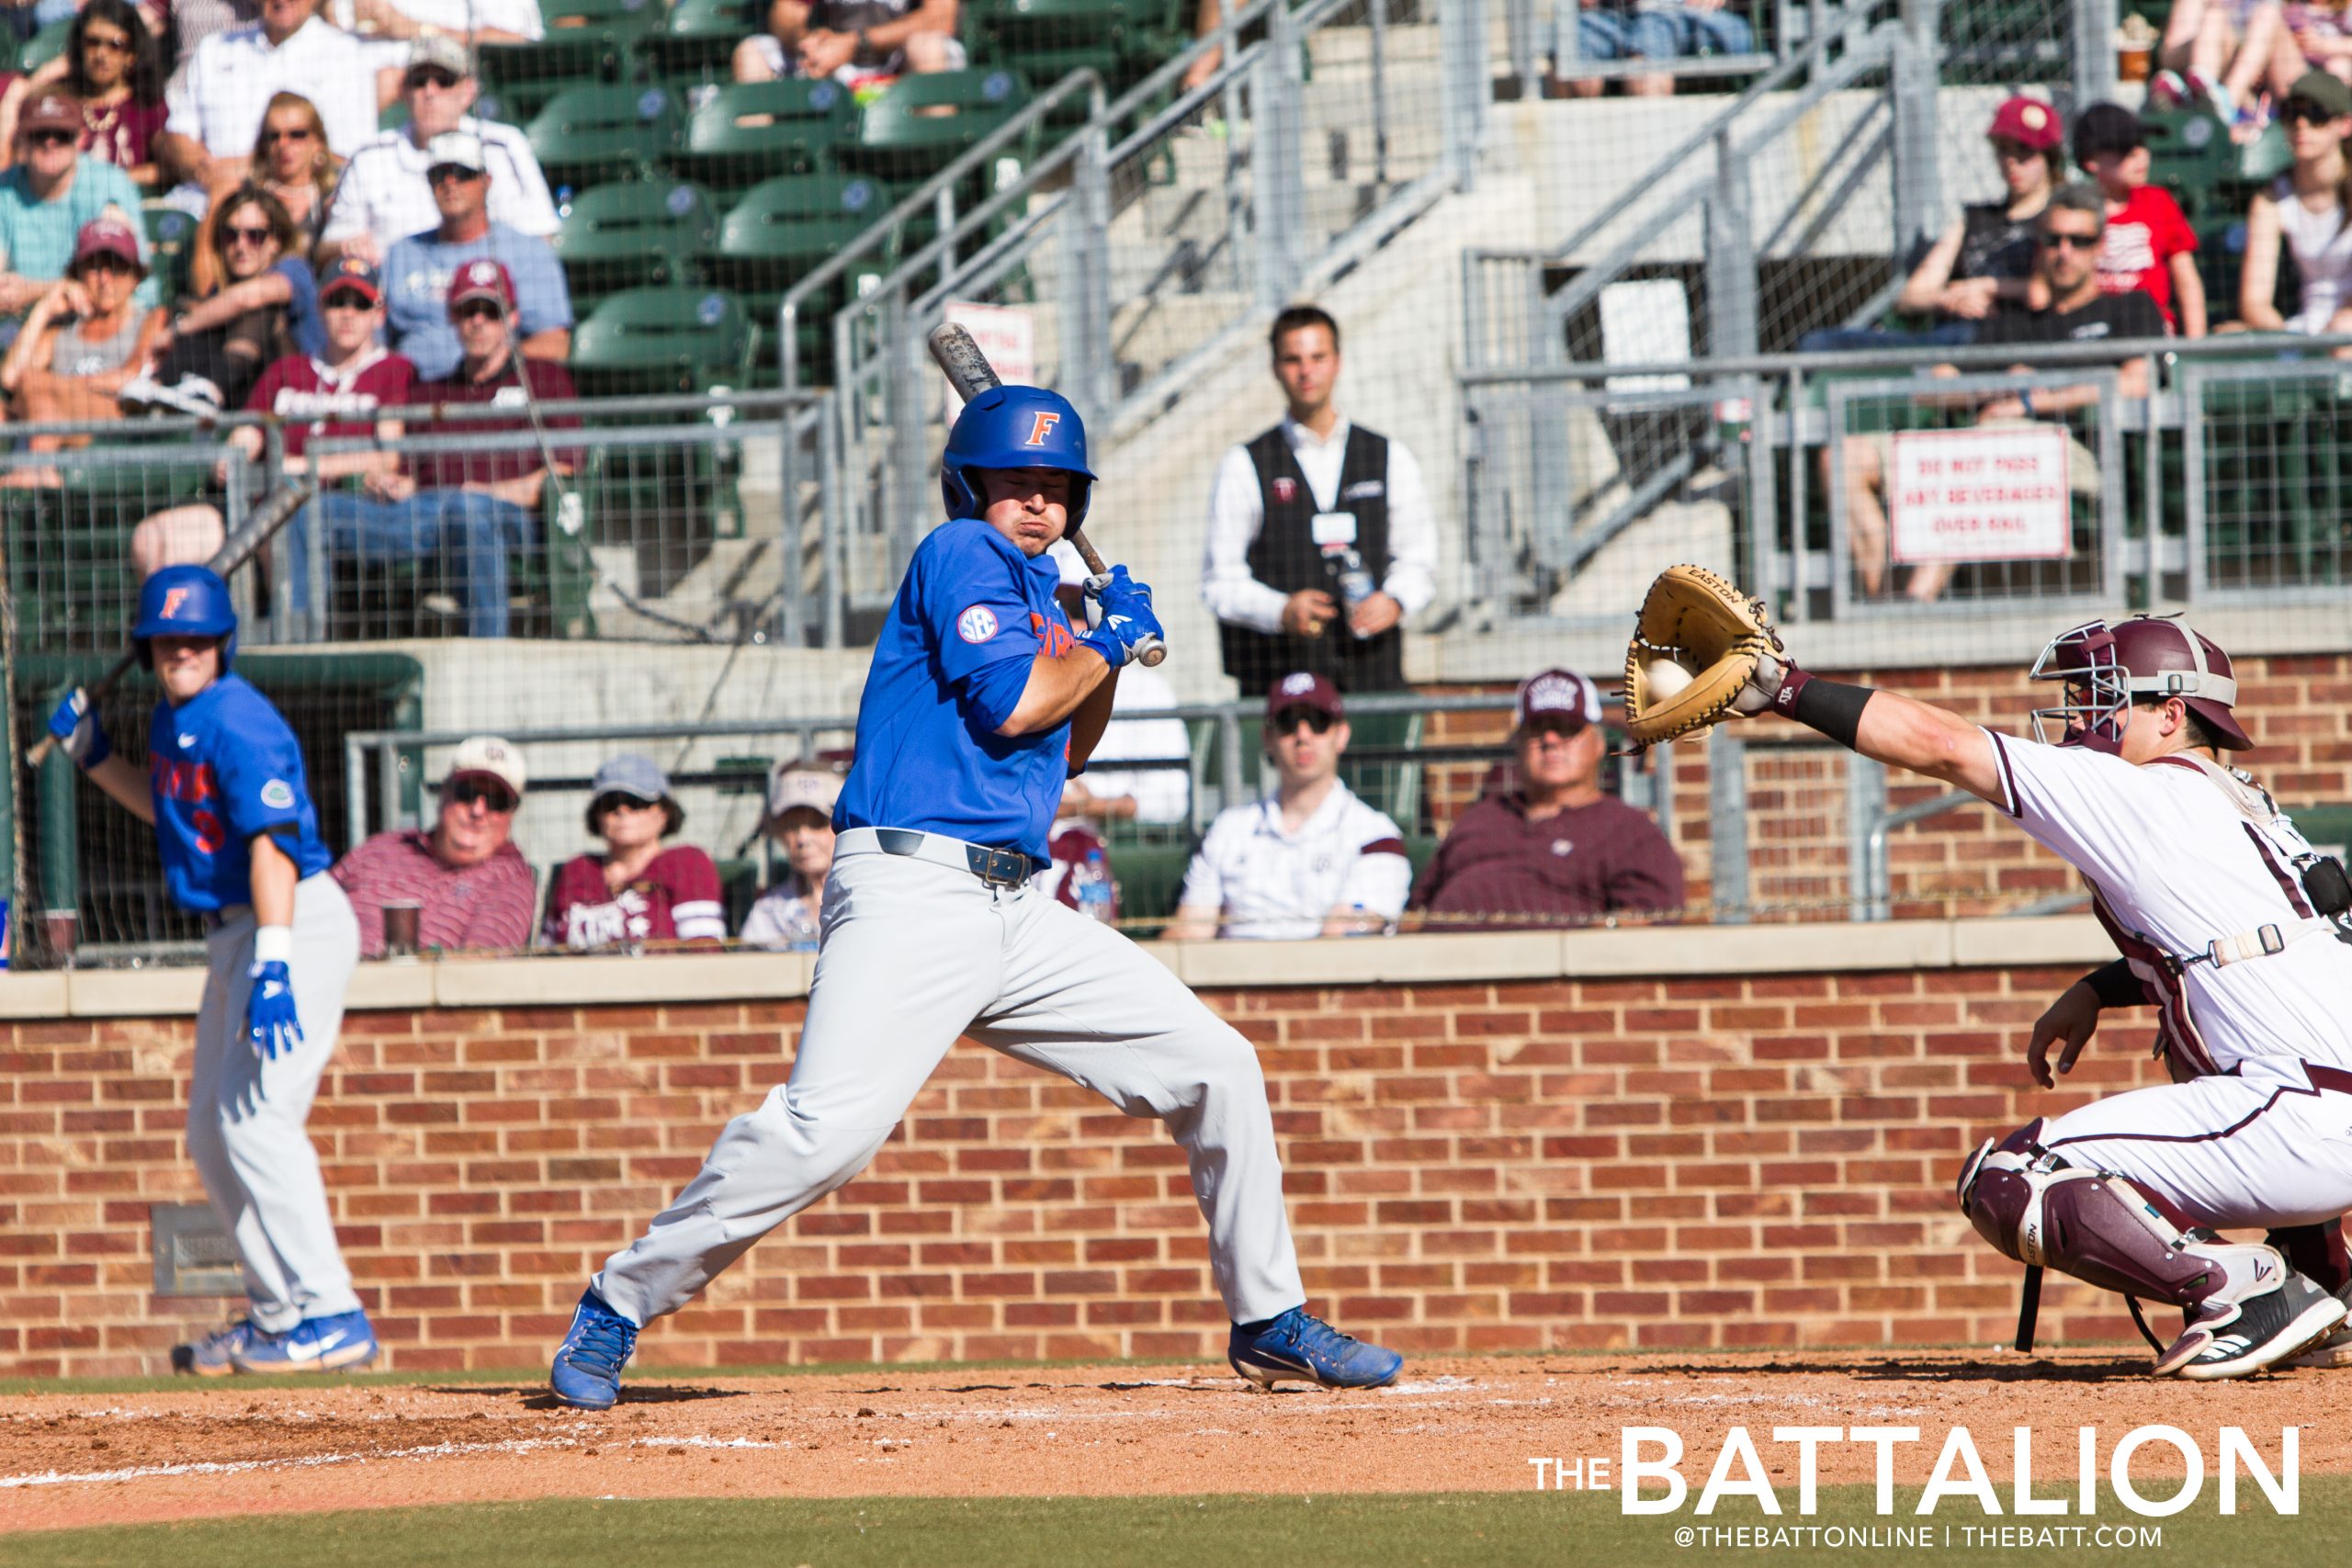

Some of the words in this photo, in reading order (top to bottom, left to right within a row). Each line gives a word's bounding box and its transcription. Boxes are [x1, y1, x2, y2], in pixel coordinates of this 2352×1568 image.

[1024, 411, 1060, 446] F
[1689, 570, 1739, 604] EASTON
[159, 588, 188, 619] F
[963, 610, 996, 641] SEC
